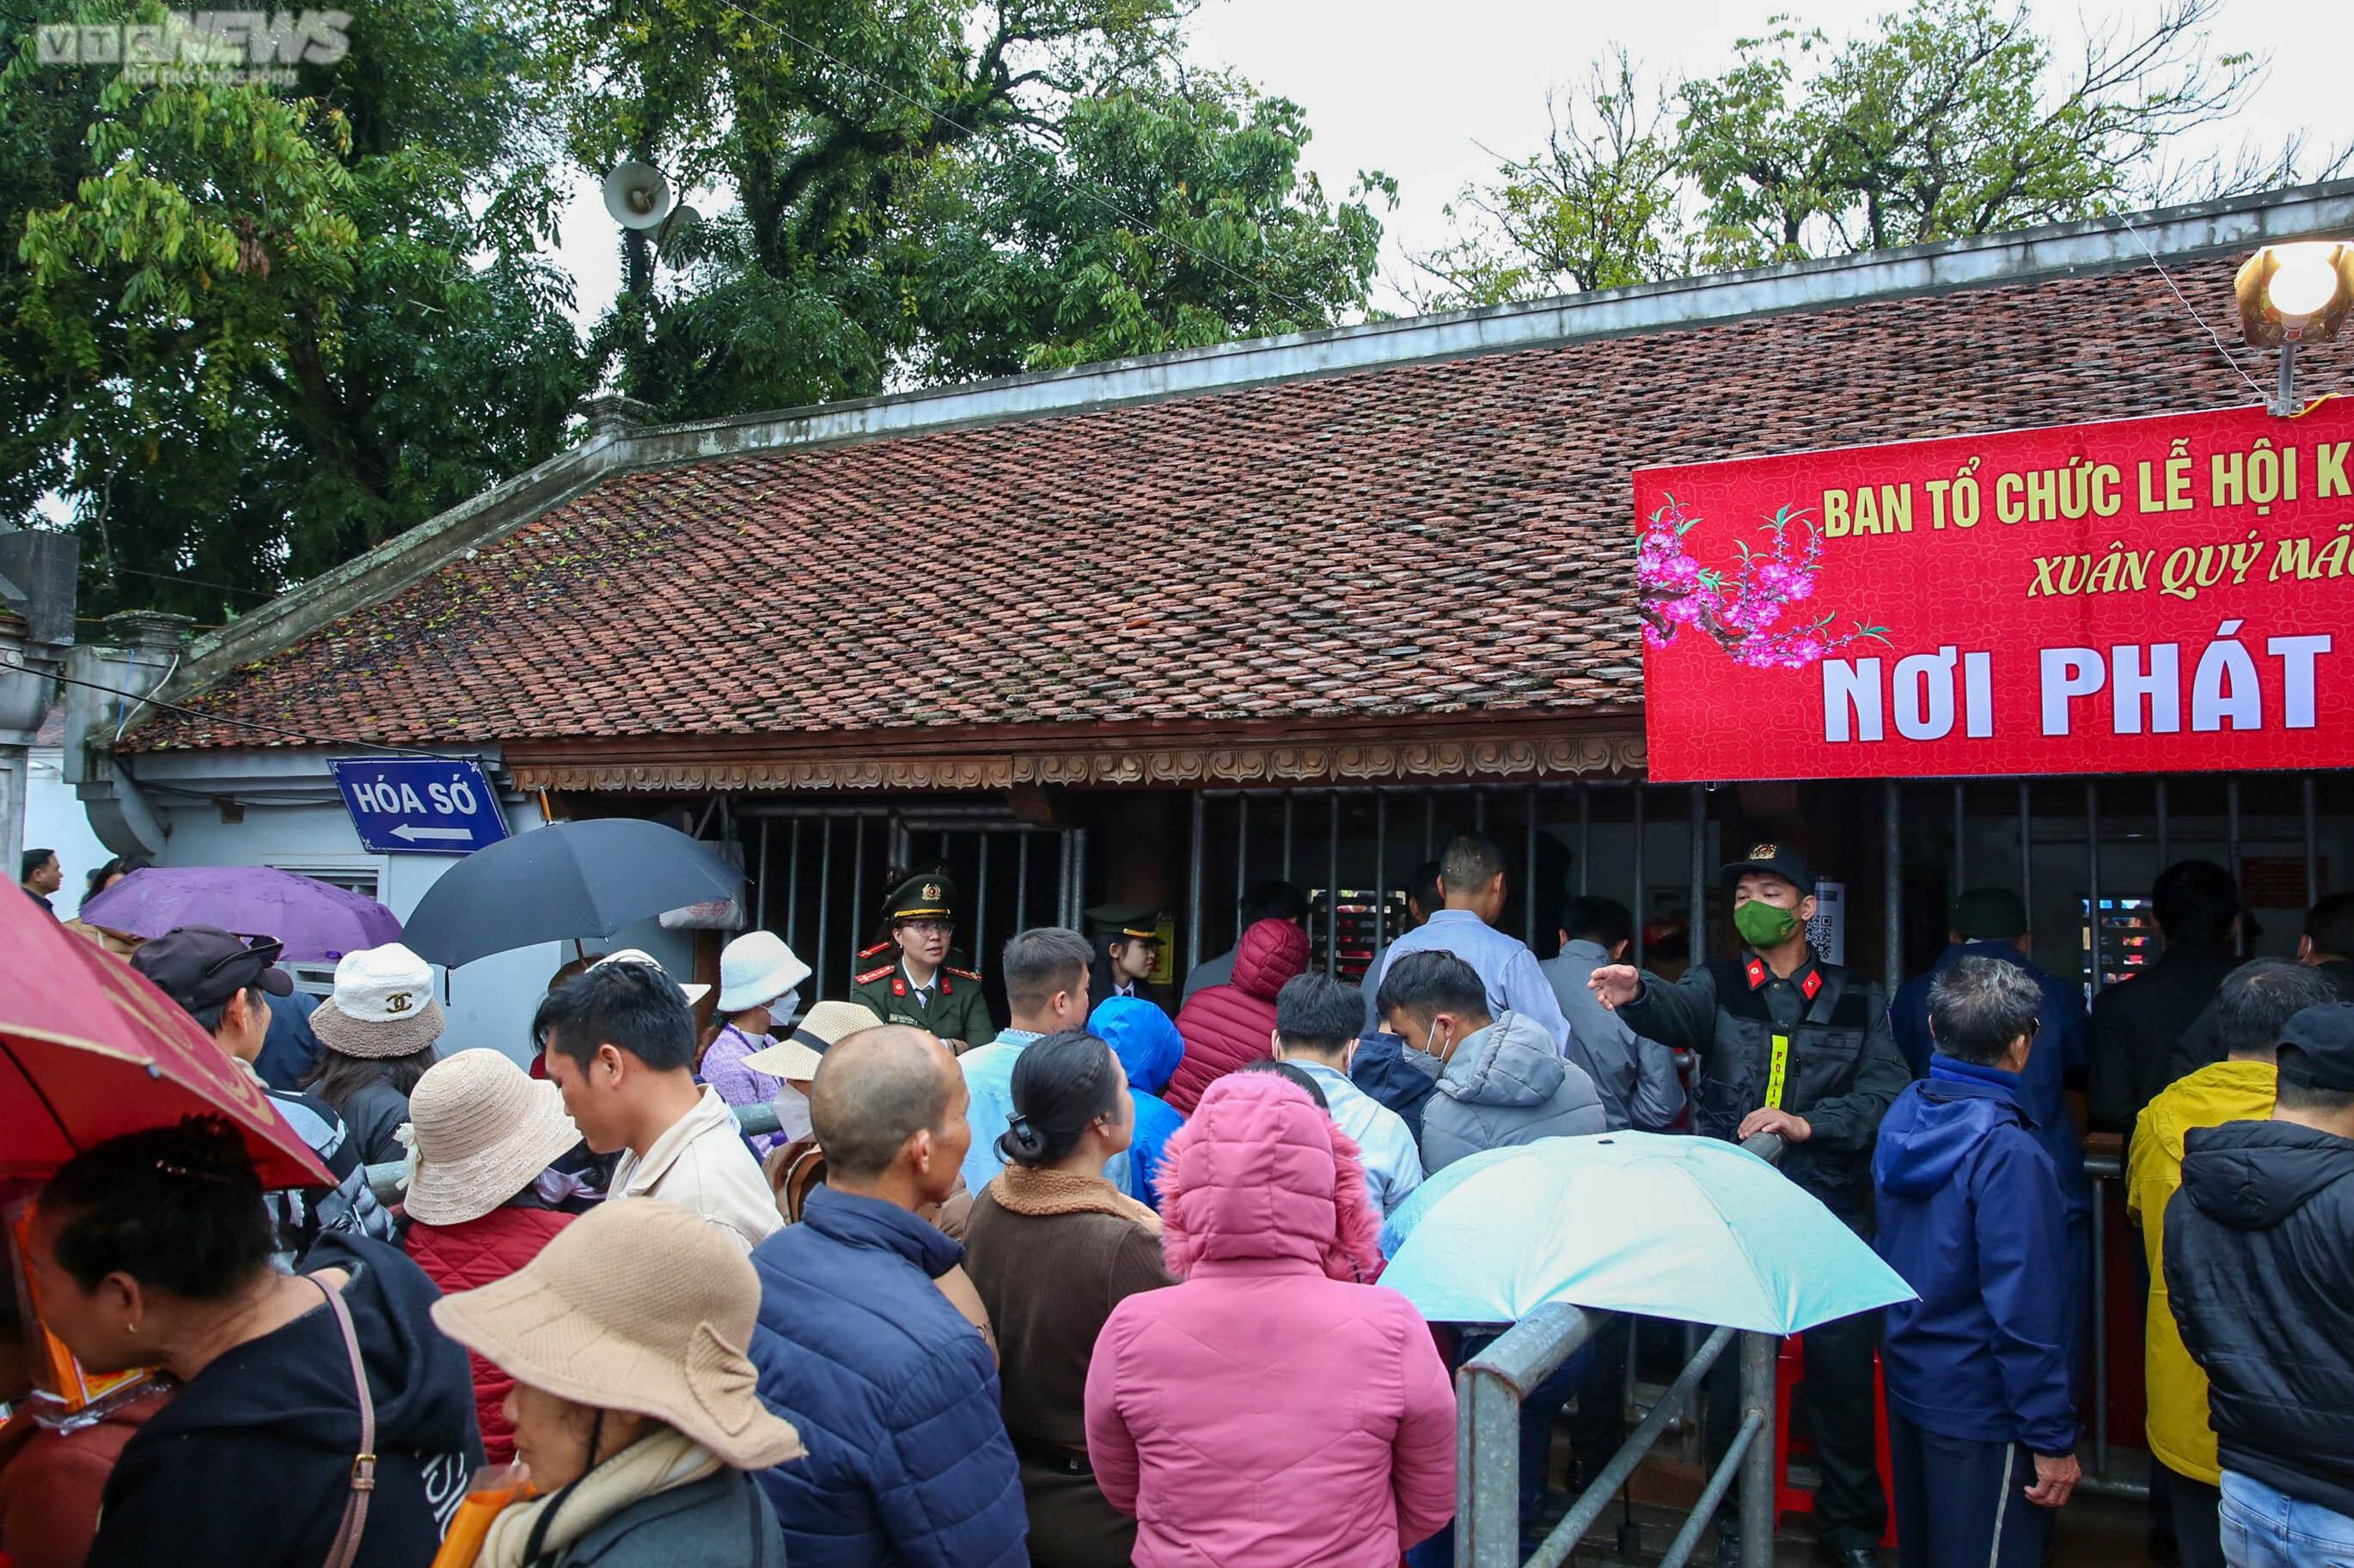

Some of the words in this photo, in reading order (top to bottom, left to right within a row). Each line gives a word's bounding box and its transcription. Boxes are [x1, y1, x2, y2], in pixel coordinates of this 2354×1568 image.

[1823, 486, 1912, 538] BAN
[1925, 455, 1982, 529] TỔ
[1996, 459, 2121, 524] CHỨC
[2138, 437, 2194, 513] LỄ
[2212, 436, 2297, 516] HỘI
[2027, 540, 2156, 599] XUÂN
[2160, 529, 2265, 601] QUÝ
[2268, 523, 2354, 583] MÃ
[1822, 644, 1993, 742] NƠI
[2040, 619, 2332, 736] PHÁT
[352, 774, 428, 814] HÓA
[428, 773, 478, 815] SỚ
